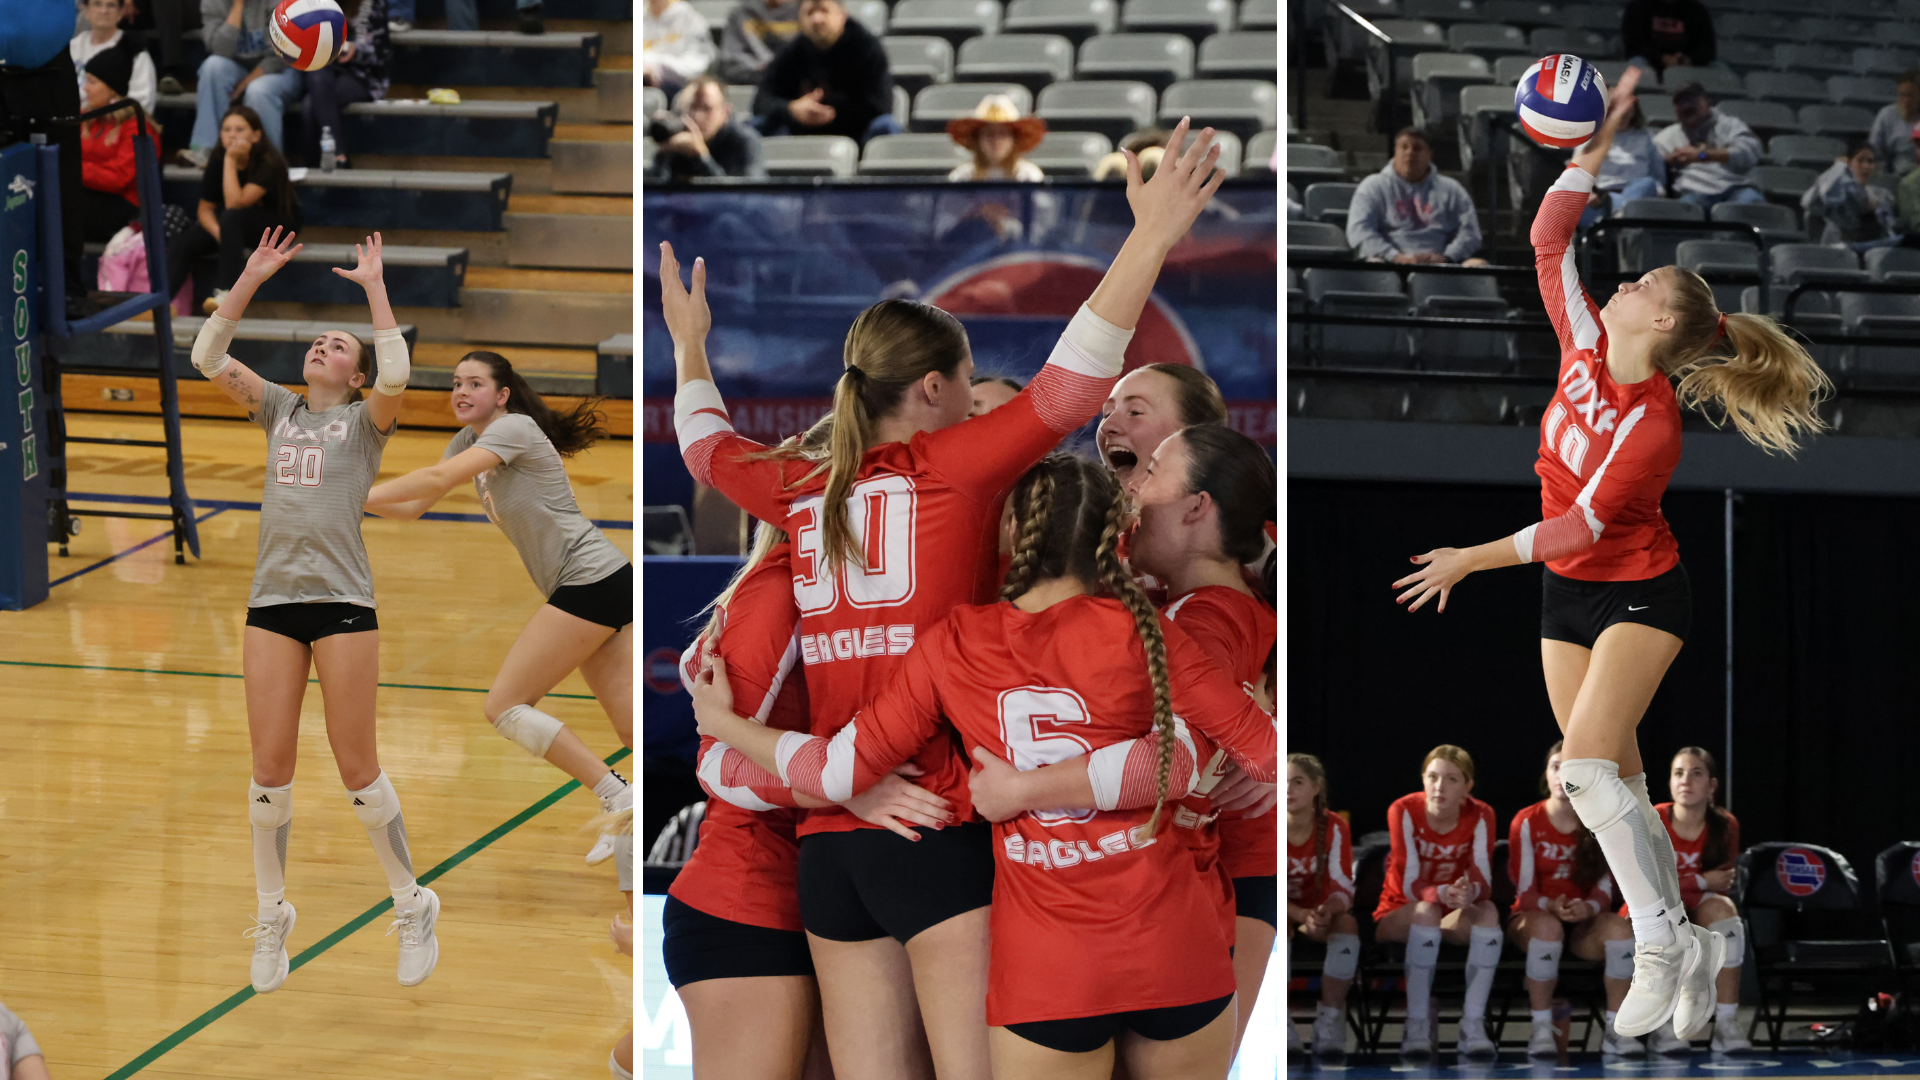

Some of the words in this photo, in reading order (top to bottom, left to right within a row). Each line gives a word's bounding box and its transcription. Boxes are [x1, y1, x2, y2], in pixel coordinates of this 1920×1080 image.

[13, 249, 38, 482] SOUTH
[274, 443, 324, 488] 20
[787, 473, 917, 618] 30
[801, 623, 915, 666] EAGLES
